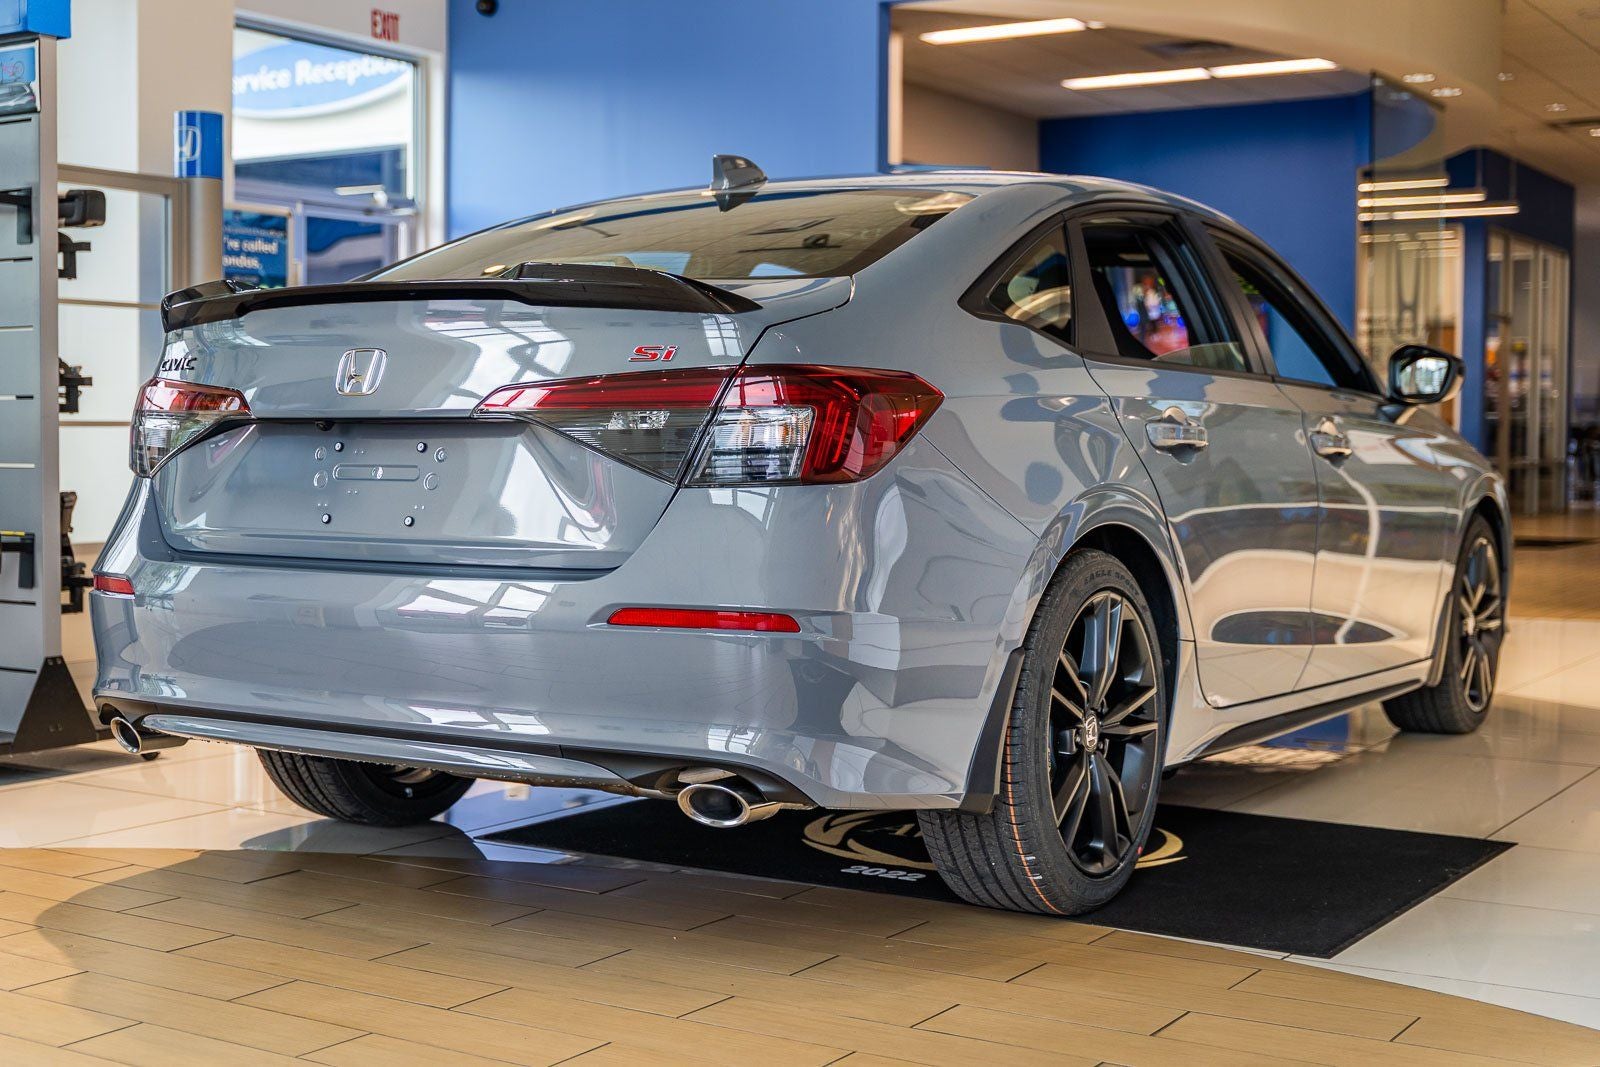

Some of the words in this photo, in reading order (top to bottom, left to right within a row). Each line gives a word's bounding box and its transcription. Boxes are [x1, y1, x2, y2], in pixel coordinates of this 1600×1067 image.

[370, 8, 400, 43] EXIT
[242, 239, 278, 255] called
[628, 345, 678, 362] Si
[161, 357, 197, 371] CIVIC
[840, 865, 927, 882] 2022
